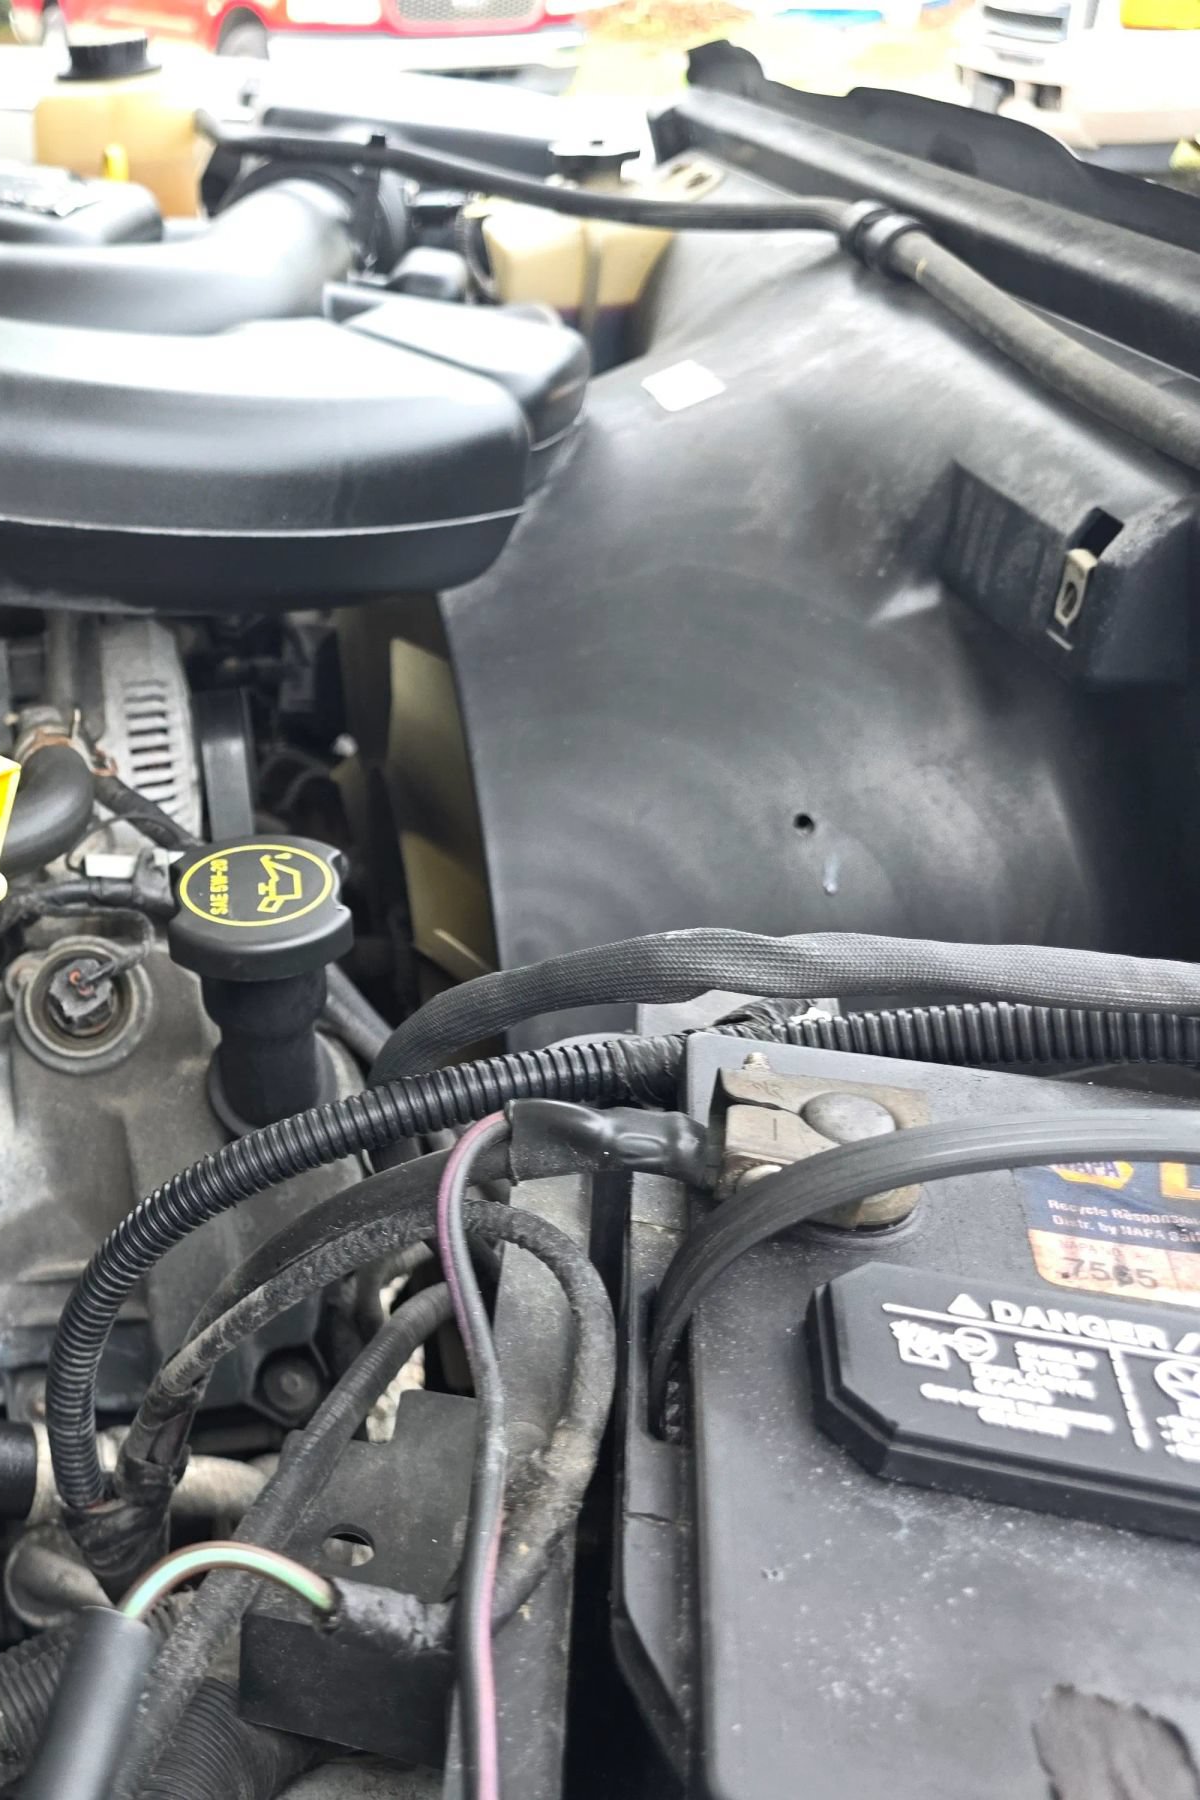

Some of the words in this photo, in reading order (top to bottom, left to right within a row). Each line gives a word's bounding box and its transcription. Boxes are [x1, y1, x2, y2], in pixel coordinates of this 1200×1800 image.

[210, 858, 229, 893] 5W-20
[210, 893, 229, 915] SAE
[990, 1299, 1170, 1351] DANGER
